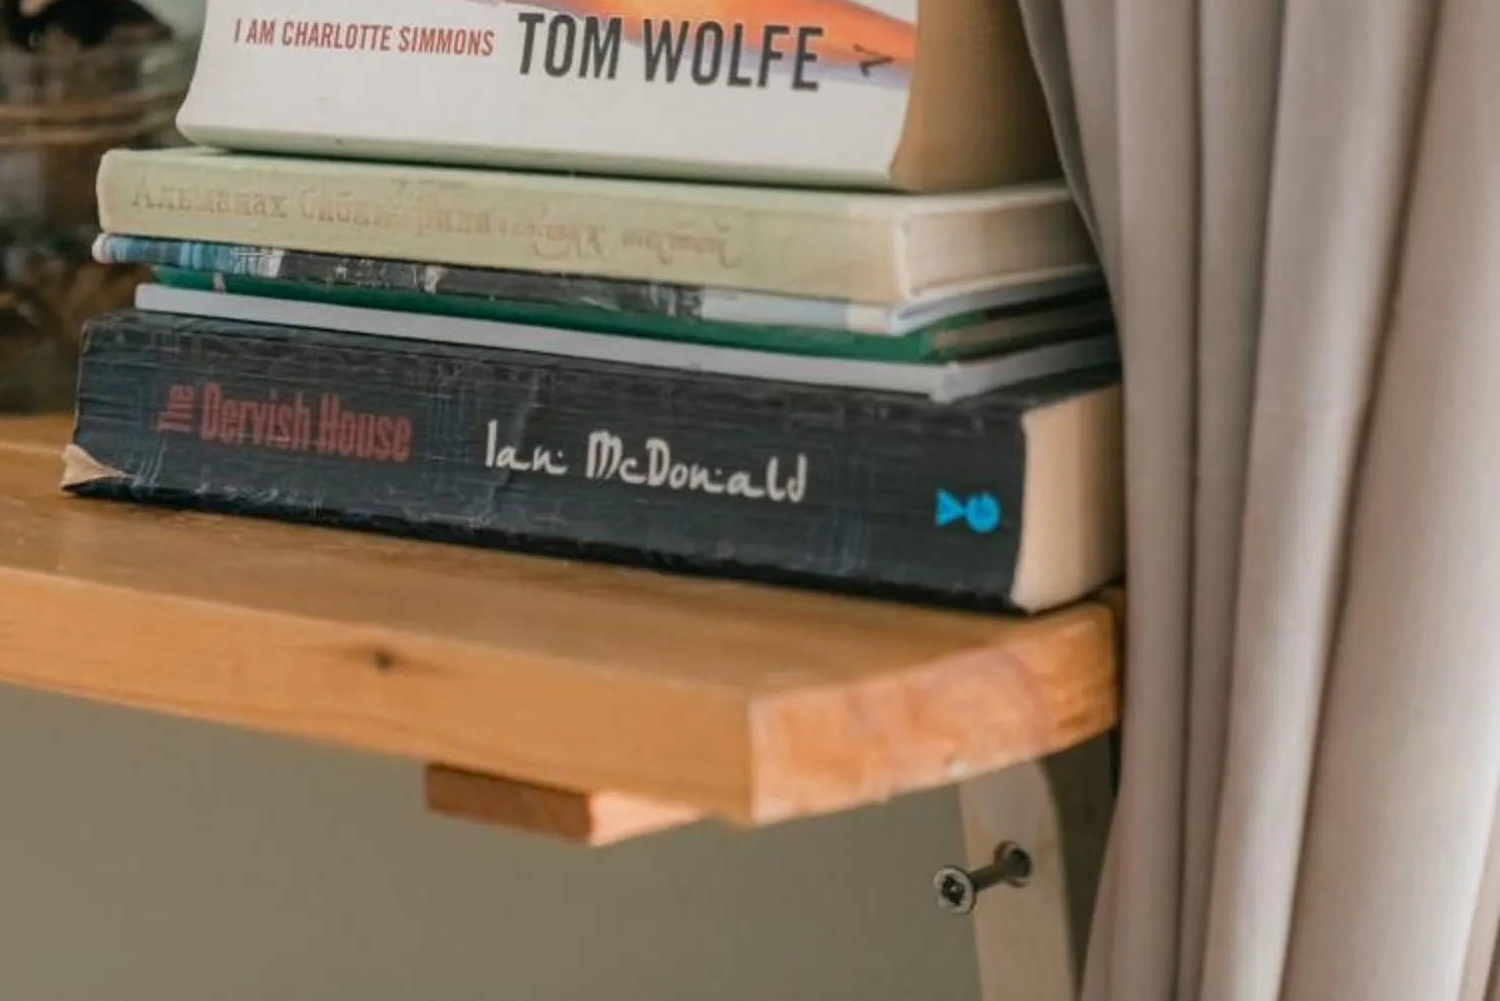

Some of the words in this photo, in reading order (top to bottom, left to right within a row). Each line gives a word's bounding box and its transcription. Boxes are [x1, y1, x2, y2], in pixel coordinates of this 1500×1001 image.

[233, 17, 243, 45] I
[246, 17, 277, 47] AM
[281, 20, 393, 53] CHARLOTTE
[397, 25, 496, 57] SIMMONS
[518, 11, 623, 81] TOM
[642, 17, 825, 92] WOLFE
[157, 383, 195, 433] The
[200, 380, 311, 451] Dervish
[315, 391, 414, 464] House
[485, 419, 568, 477] Ian
[584, 429, 808, 503] McDonald
